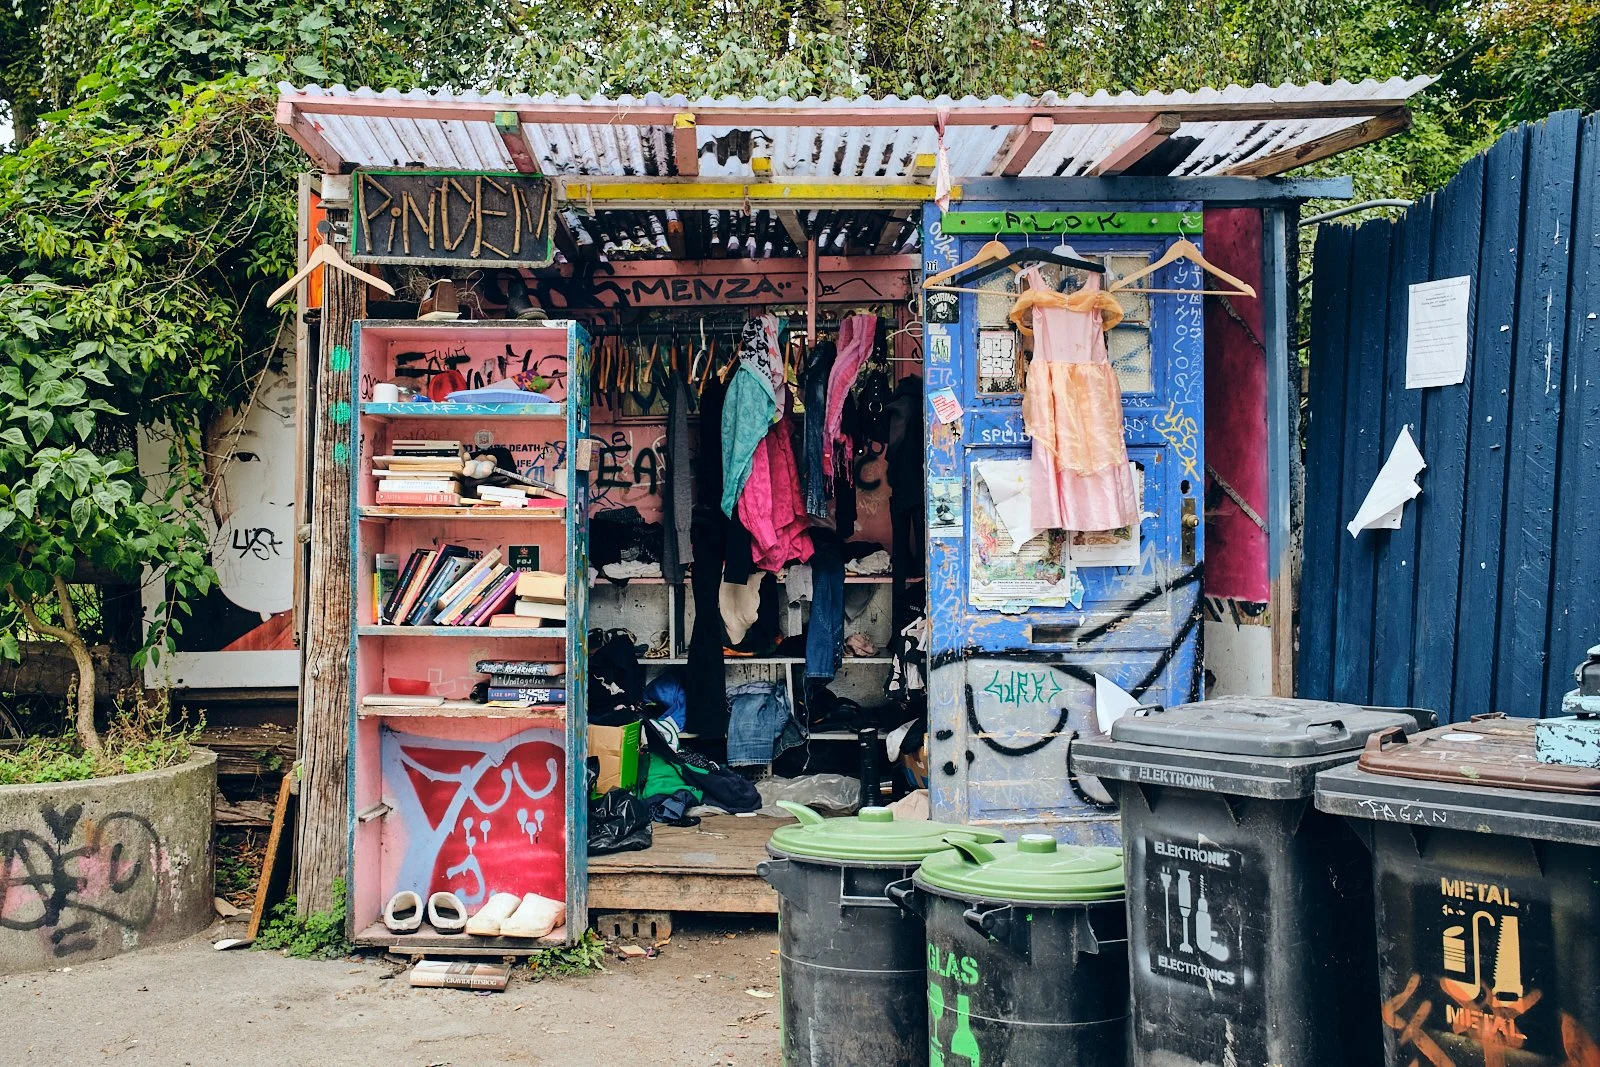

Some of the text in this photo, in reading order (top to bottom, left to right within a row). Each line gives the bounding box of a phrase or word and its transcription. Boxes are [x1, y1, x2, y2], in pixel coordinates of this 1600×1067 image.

[516, 459, 532, 468] IFE
[1139, 766, 1215, 790] ELEKTRONIK
[1153, 841, 1231, 867] ELEKTRONIK
[1440, 877, 1520, 909] METAL
[927, 942, 979, 985] GLAS
[1158, 955, 1235, 985] ELECTRONICS
[1446, 1004, 1528, 1040] METAL
